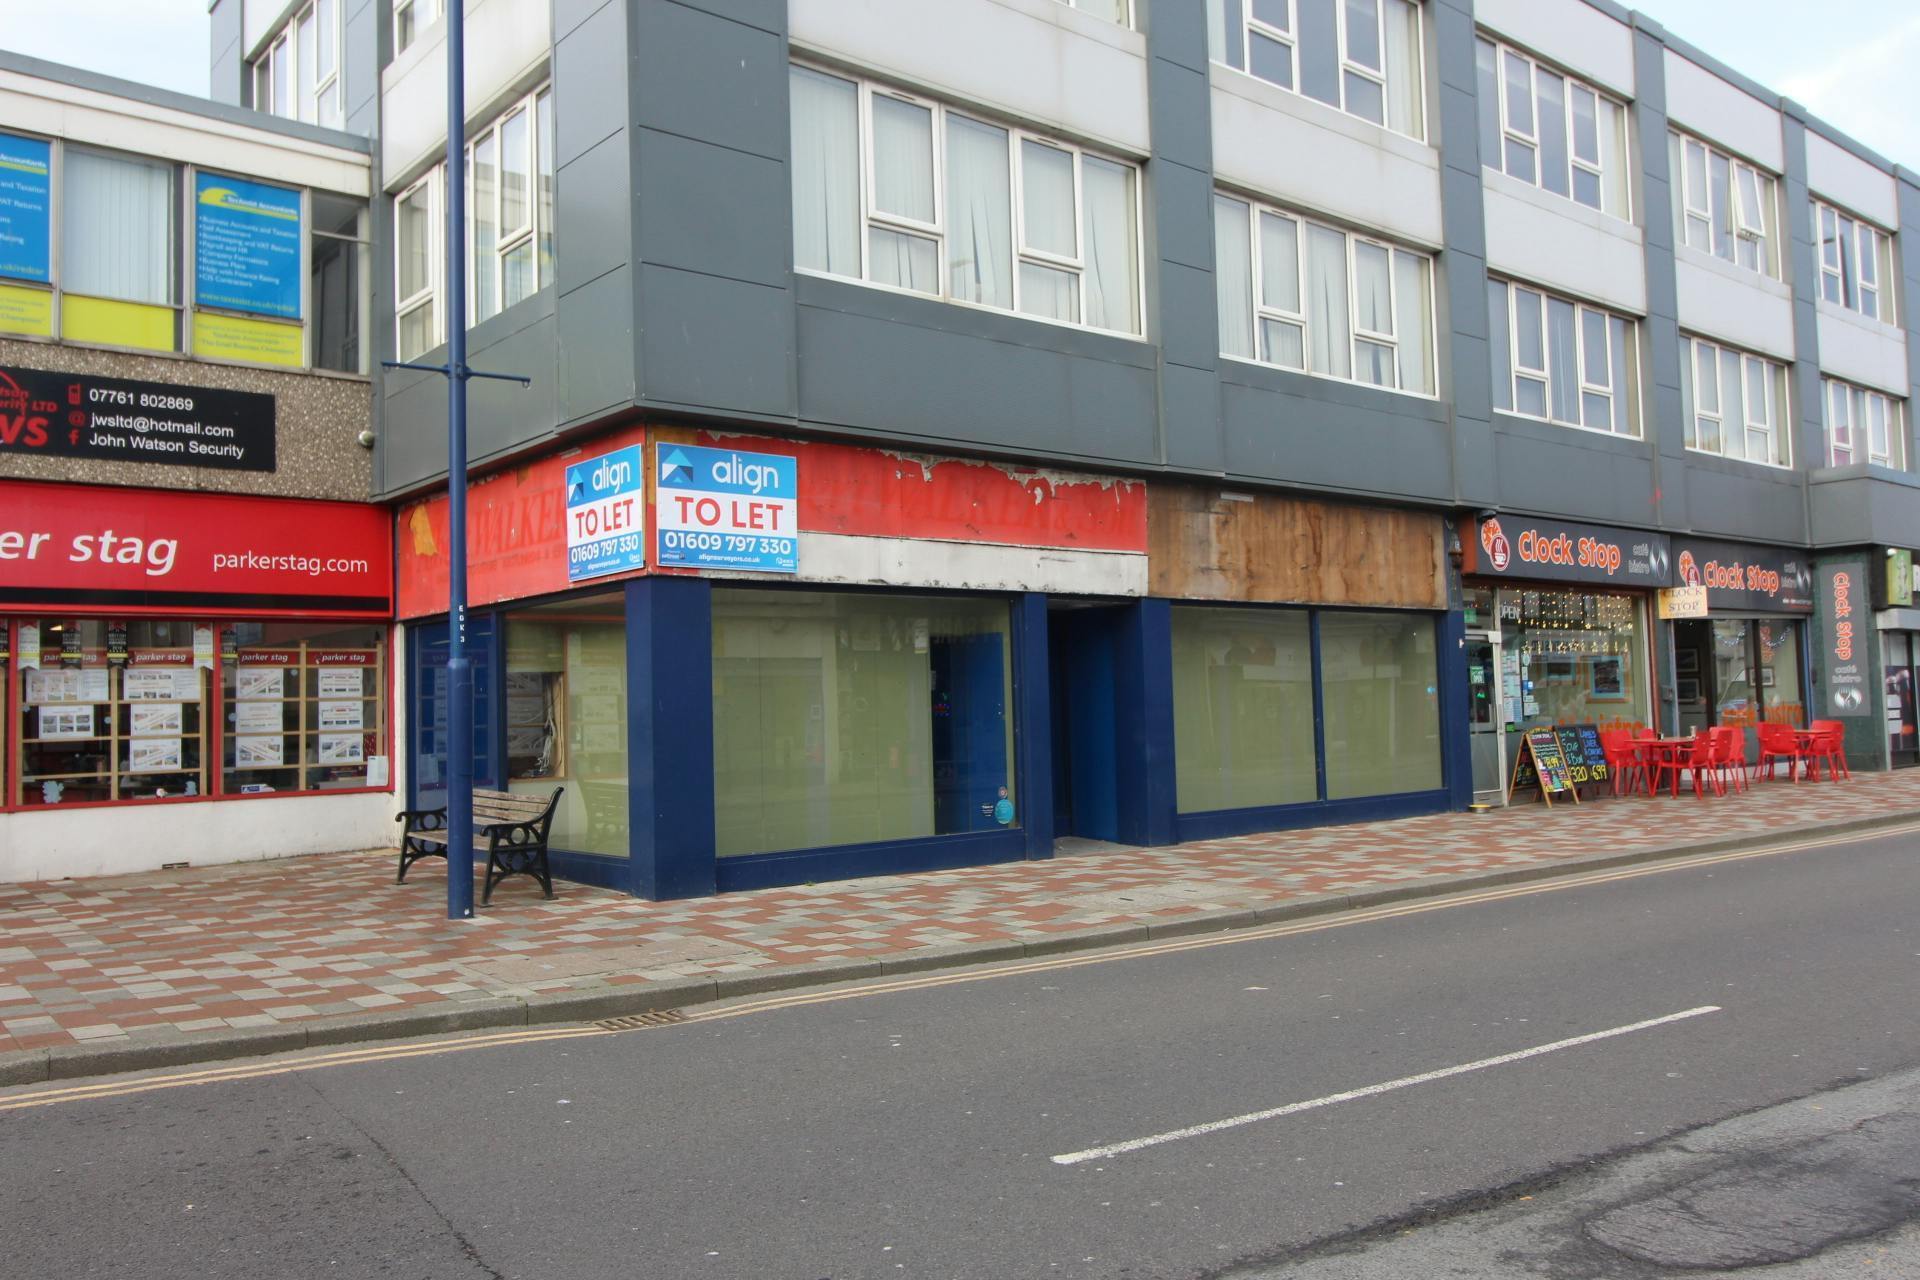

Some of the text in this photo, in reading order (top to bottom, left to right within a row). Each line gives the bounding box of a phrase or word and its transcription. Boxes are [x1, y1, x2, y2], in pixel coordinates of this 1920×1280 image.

[31, 401, 58, 413] LTD
[89, 388, 194, 411] 07761 802869
[90, 411, 234, 438] jwsltd@hotmail.com
[89, 431, 126, 448] John
[129, 434, 184, 453] Watson
[188, 440, 244, 460] Security
[592, 457, 631, 494] align
[711, 453, 779, 494] align
[575, 498, 634, 539] TO LET
[674, 495, 784, 531] TO LET
[69, 529, 178, 576] stag
[571, 543, 600, 564] 01609
[600, 538, 618, 557] 797
[619, 535, 639, 553] 330
[664, 531, 791, 555] 01609 797 330
[1518, 529, 1621, 576] Clock Stop
[213, 550, 368, 576] parkerstag.com
[1703, 559, 1779, 597] Clock Stop
[1833, 572, 1853, 660] Clock Stop
[136, 652, 187, 663] parker stag
[241, 652, 289, 663] parker stag
[321, 652, 366, 663] parker stag
